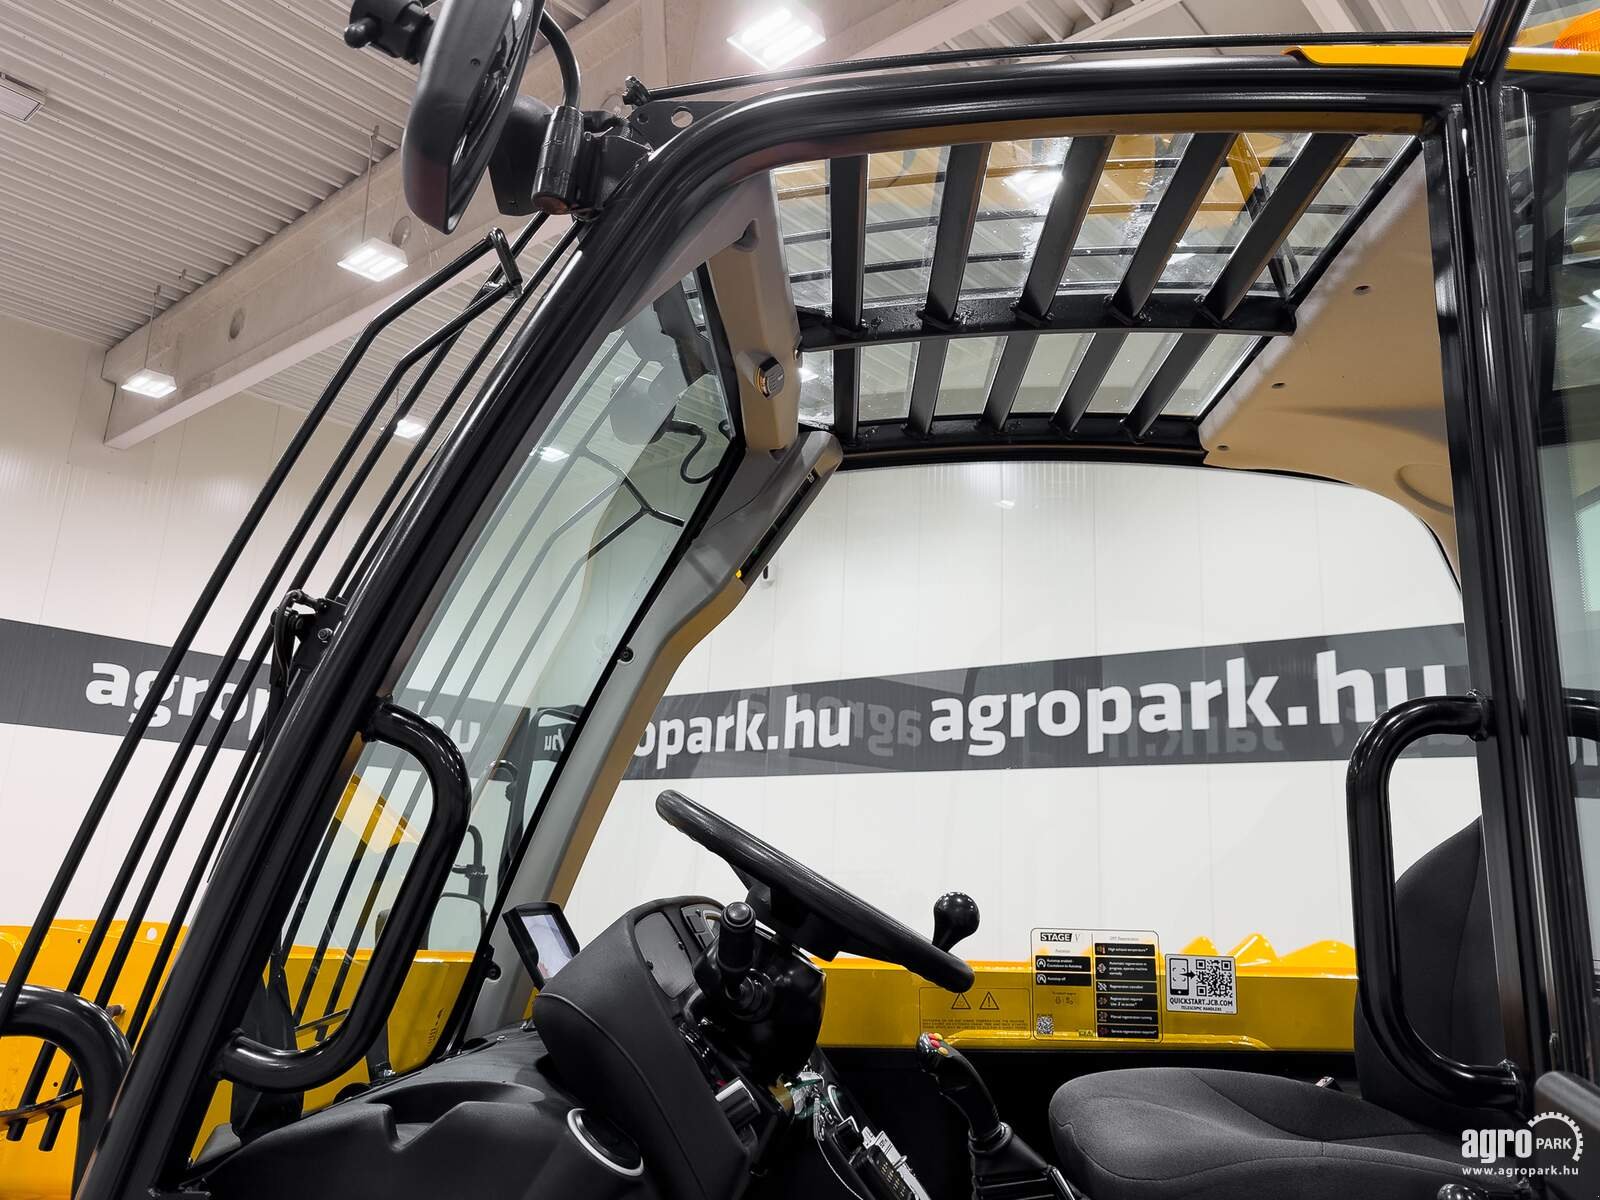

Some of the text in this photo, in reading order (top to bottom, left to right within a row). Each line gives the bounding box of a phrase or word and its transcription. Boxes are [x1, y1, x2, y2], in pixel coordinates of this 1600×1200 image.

[929, 650, 1448, 757] agropark.hu
[1041, 933, 1071, 941] STAGE
[1169, 997, 1233, 1006] QUICKSTART.JCB.COM
